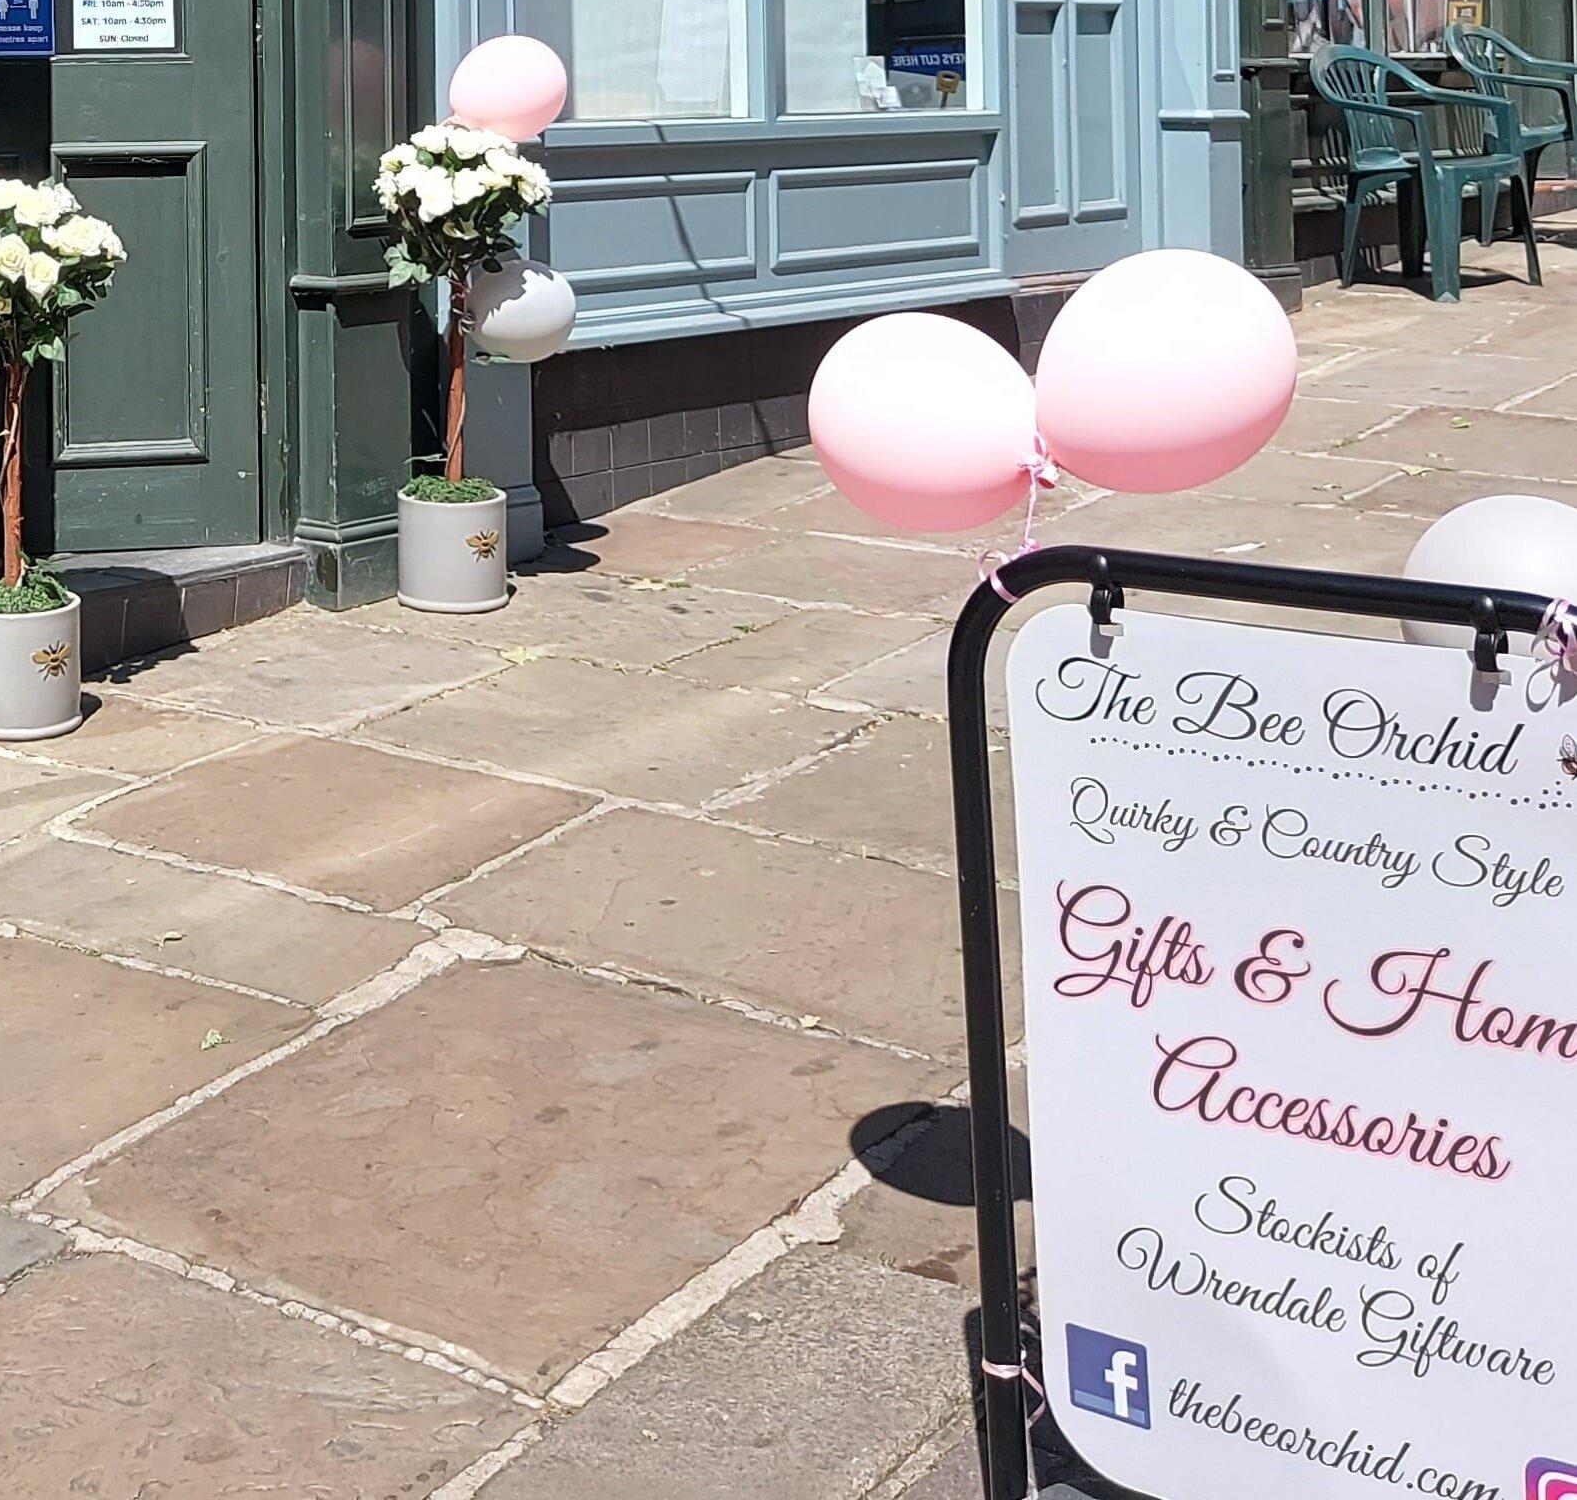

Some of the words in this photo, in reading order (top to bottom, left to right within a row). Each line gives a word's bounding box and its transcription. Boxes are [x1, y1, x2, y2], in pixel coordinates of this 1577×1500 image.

[23, 24, 43, 33] keep
[27, 35, 49, 45] apart
[120, 34, 149, 43] Closed
[1035, 656, 1158, 724] The
[1171, 670, 1306, 747] Bee
[1322, 688, 1526, 776] Orchid
[1069, 776, 1200, 853] Quirky
[1209, 805, 1252, 847] &
[1260, 803, 1421, 889] Country
[1431, 833, 1565, 908] Style
[1053, 879, 1214, 1009] Gifts
[1233, 928, 1311, 1005] &
[1151, 1033, 1513, 1180] Accessories
[1194, 1175, 1403, 1272] Stockists
[1416, 1241, 1465, 1305] of
[1116, 1226, 1347, 1334] Wrendale
[1355, 1283, 1556, 1387] Giftware
[1167, 1377, 1506, 1500] thebeeorchid.com
